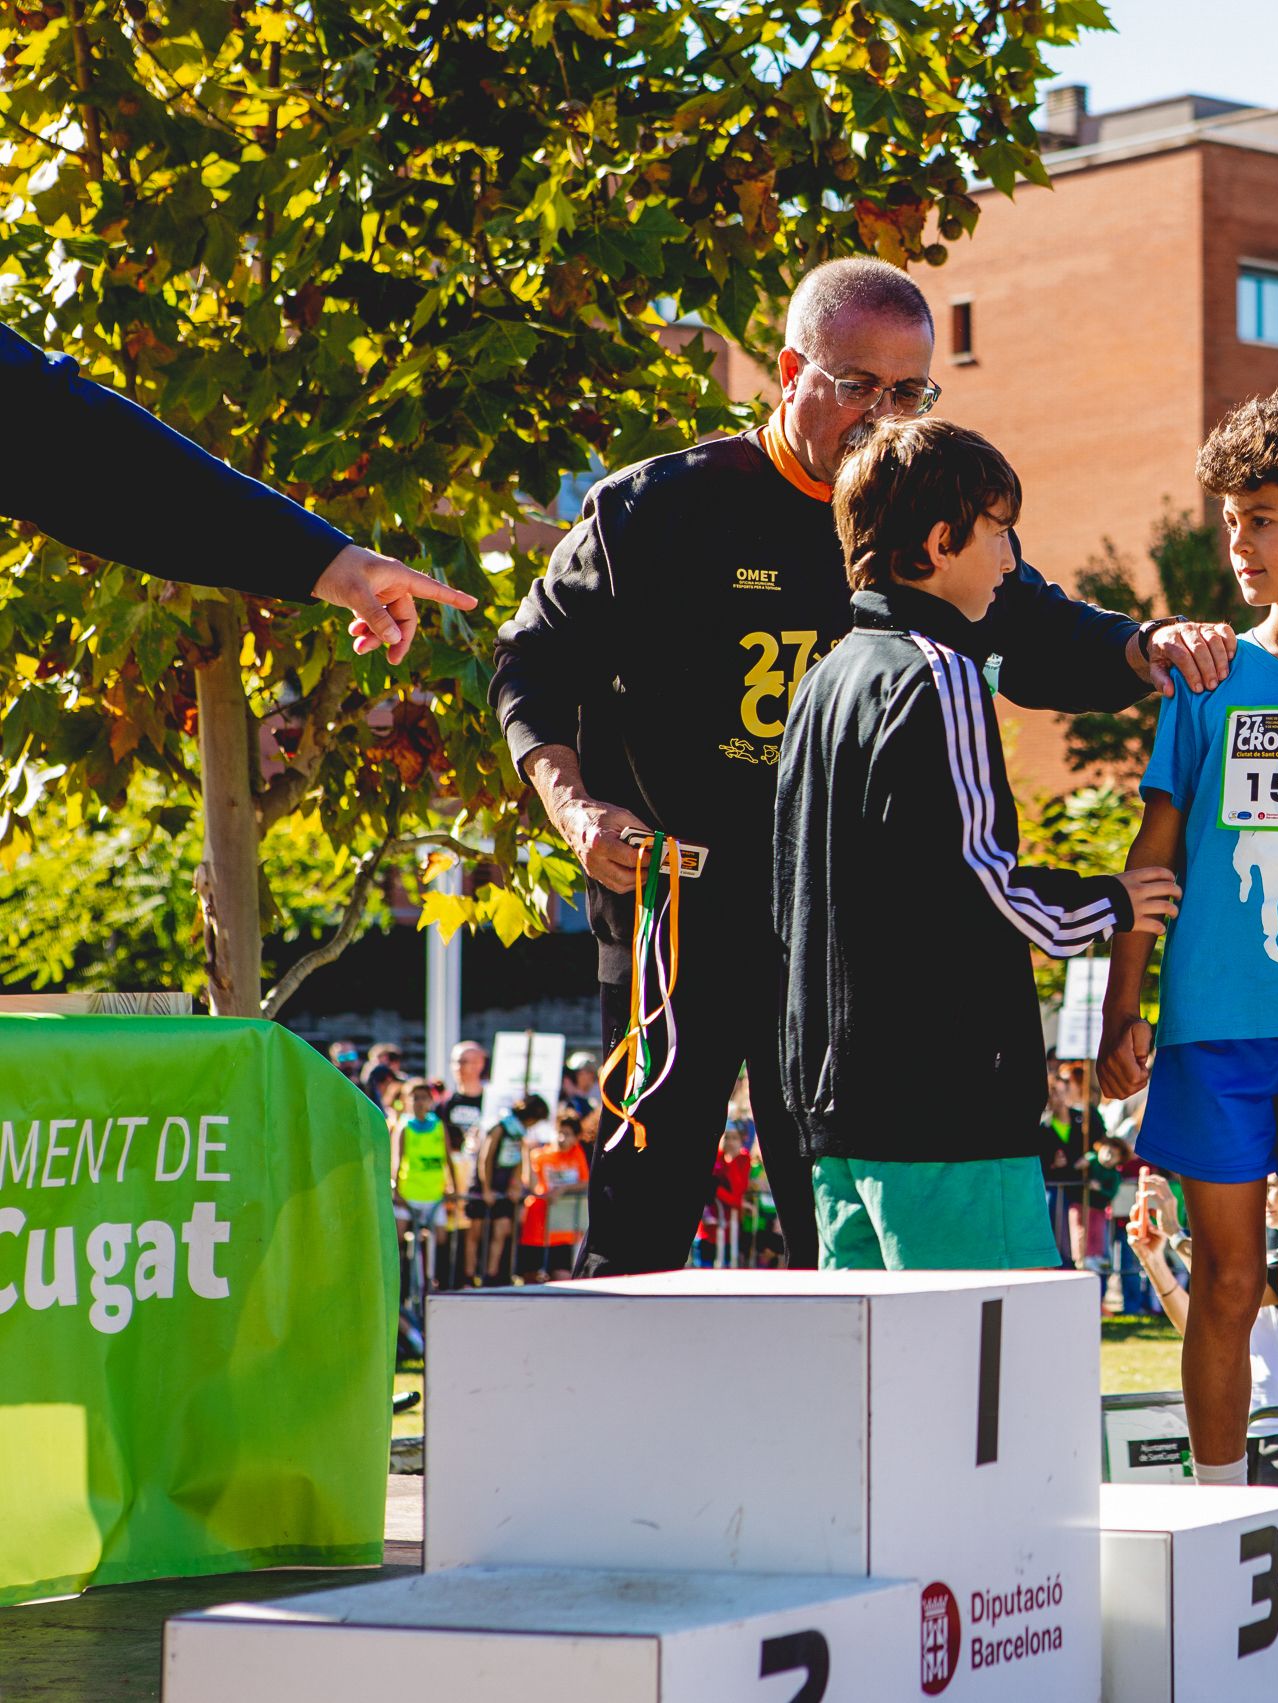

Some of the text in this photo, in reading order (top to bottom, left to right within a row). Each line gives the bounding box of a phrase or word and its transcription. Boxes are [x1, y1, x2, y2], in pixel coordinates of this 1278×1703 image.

[736, 568, 778, 581] OMET
[739, 631, 823, 686] 27
[155, 1115, 231, 1182] DE
[0, 1201, 231, 1334] Cugat
[971, 1572, 1063, 1627] Diputació
[971, 1624, 1063, 1671] Barcelona
